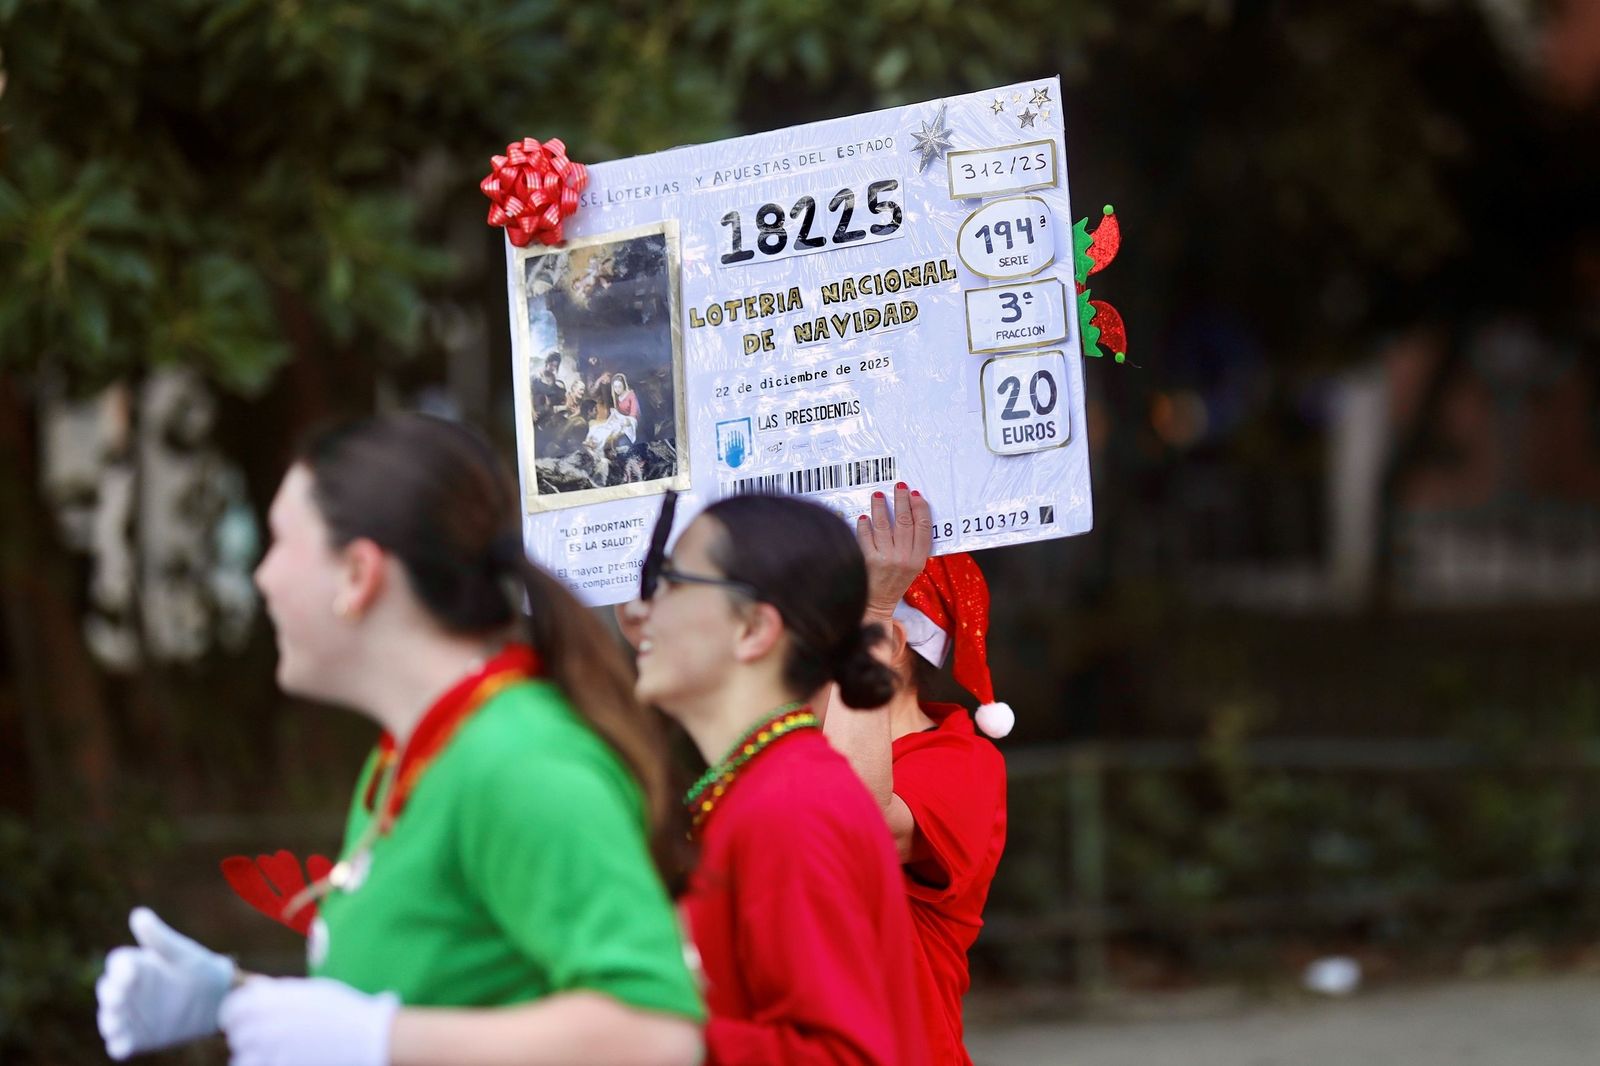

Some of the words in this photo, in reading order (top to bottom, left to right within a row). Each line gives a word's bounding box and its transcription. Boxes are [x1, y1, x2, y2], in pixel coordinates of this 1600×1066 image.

[607, 181, 680, 203] LOTERIAS
[713, 158, 790, 186] APUESTAS
[800, 151, 826, 167] DEL
[837, 137, 894, 159] ESTADO
[961, 153, 1047, 180] 312/25
[720, 179, 903, 265] 18225
[999, 254, 1030, 268] SERIE
[689, 286, 804, 329] LOTERIA
[820, 259, 957, 306] NACIONAL
[998, 291, 1034, 323] 3ª
[743, 328, 776, 356] DE
[793, 300, 920, 344] NAVIDAD
[996, 324, 1046, 341] FRACCION
[715, 386, 730, 399] 22
[737, 381, 753, 394] de
[759, 368, 829, 391] diciembre
[835, 363, 852, 376] de
[859, 356, 891, 373] 2025
[996, 369, 1058, 421] 20
[757, 413, 779, 431] LAS
[785, 399, 861, 426] PRESIDENTAS
[1002, 420, 1056, 445] EUROS
[583, 517, 645, 536] IMPORTANTE
[961, 510, 1030, 535] 210379
[569, 543, 582, 553] ES
[585, 540, 598, 551] LA
[572, 565, 604, 578] mayor
[607, 556, 645, 573] premio
[582, 572, 639, 590] compartirlo
